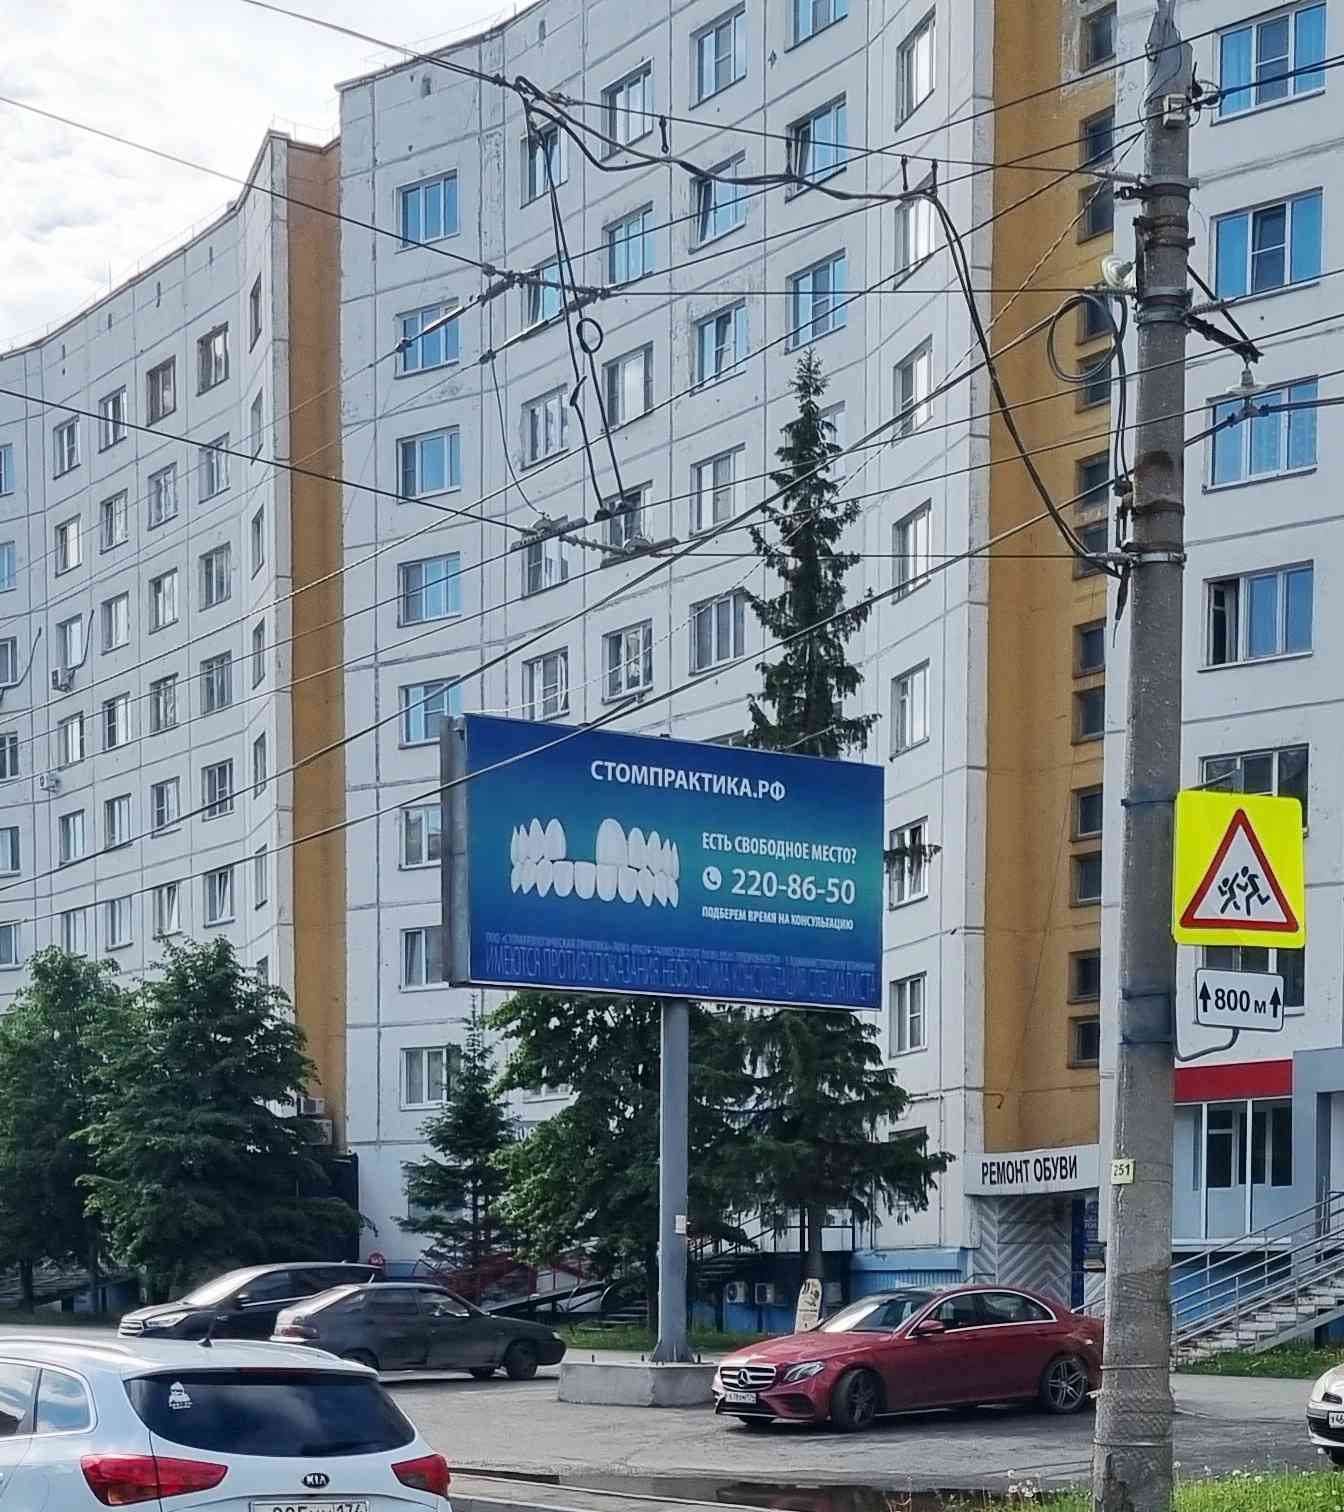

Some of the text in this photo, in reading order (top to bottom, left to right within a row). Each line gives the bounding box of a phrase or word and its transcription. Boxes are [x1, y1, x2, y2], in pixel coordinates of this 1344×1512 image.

[590, 760, 786, 801] СТОМПРАКТИКА.РФ
[702, 832, 857, 865] ЕСТЬ СВОБОДНОЕ МЕСТО?
[731, 868, 856, 905] 220-86-50
[702, 906, 854, 931] ПОДБЕРЕМ ВРЕМЯ НА КОНСУЛЬТАЦИЮ
[1214, 988, 1251, 1012] 800
[981, 1155, 1078, 1185] РЕМОНТ ОБУВИ
[1114, 1163, 1130, 1177] 251
